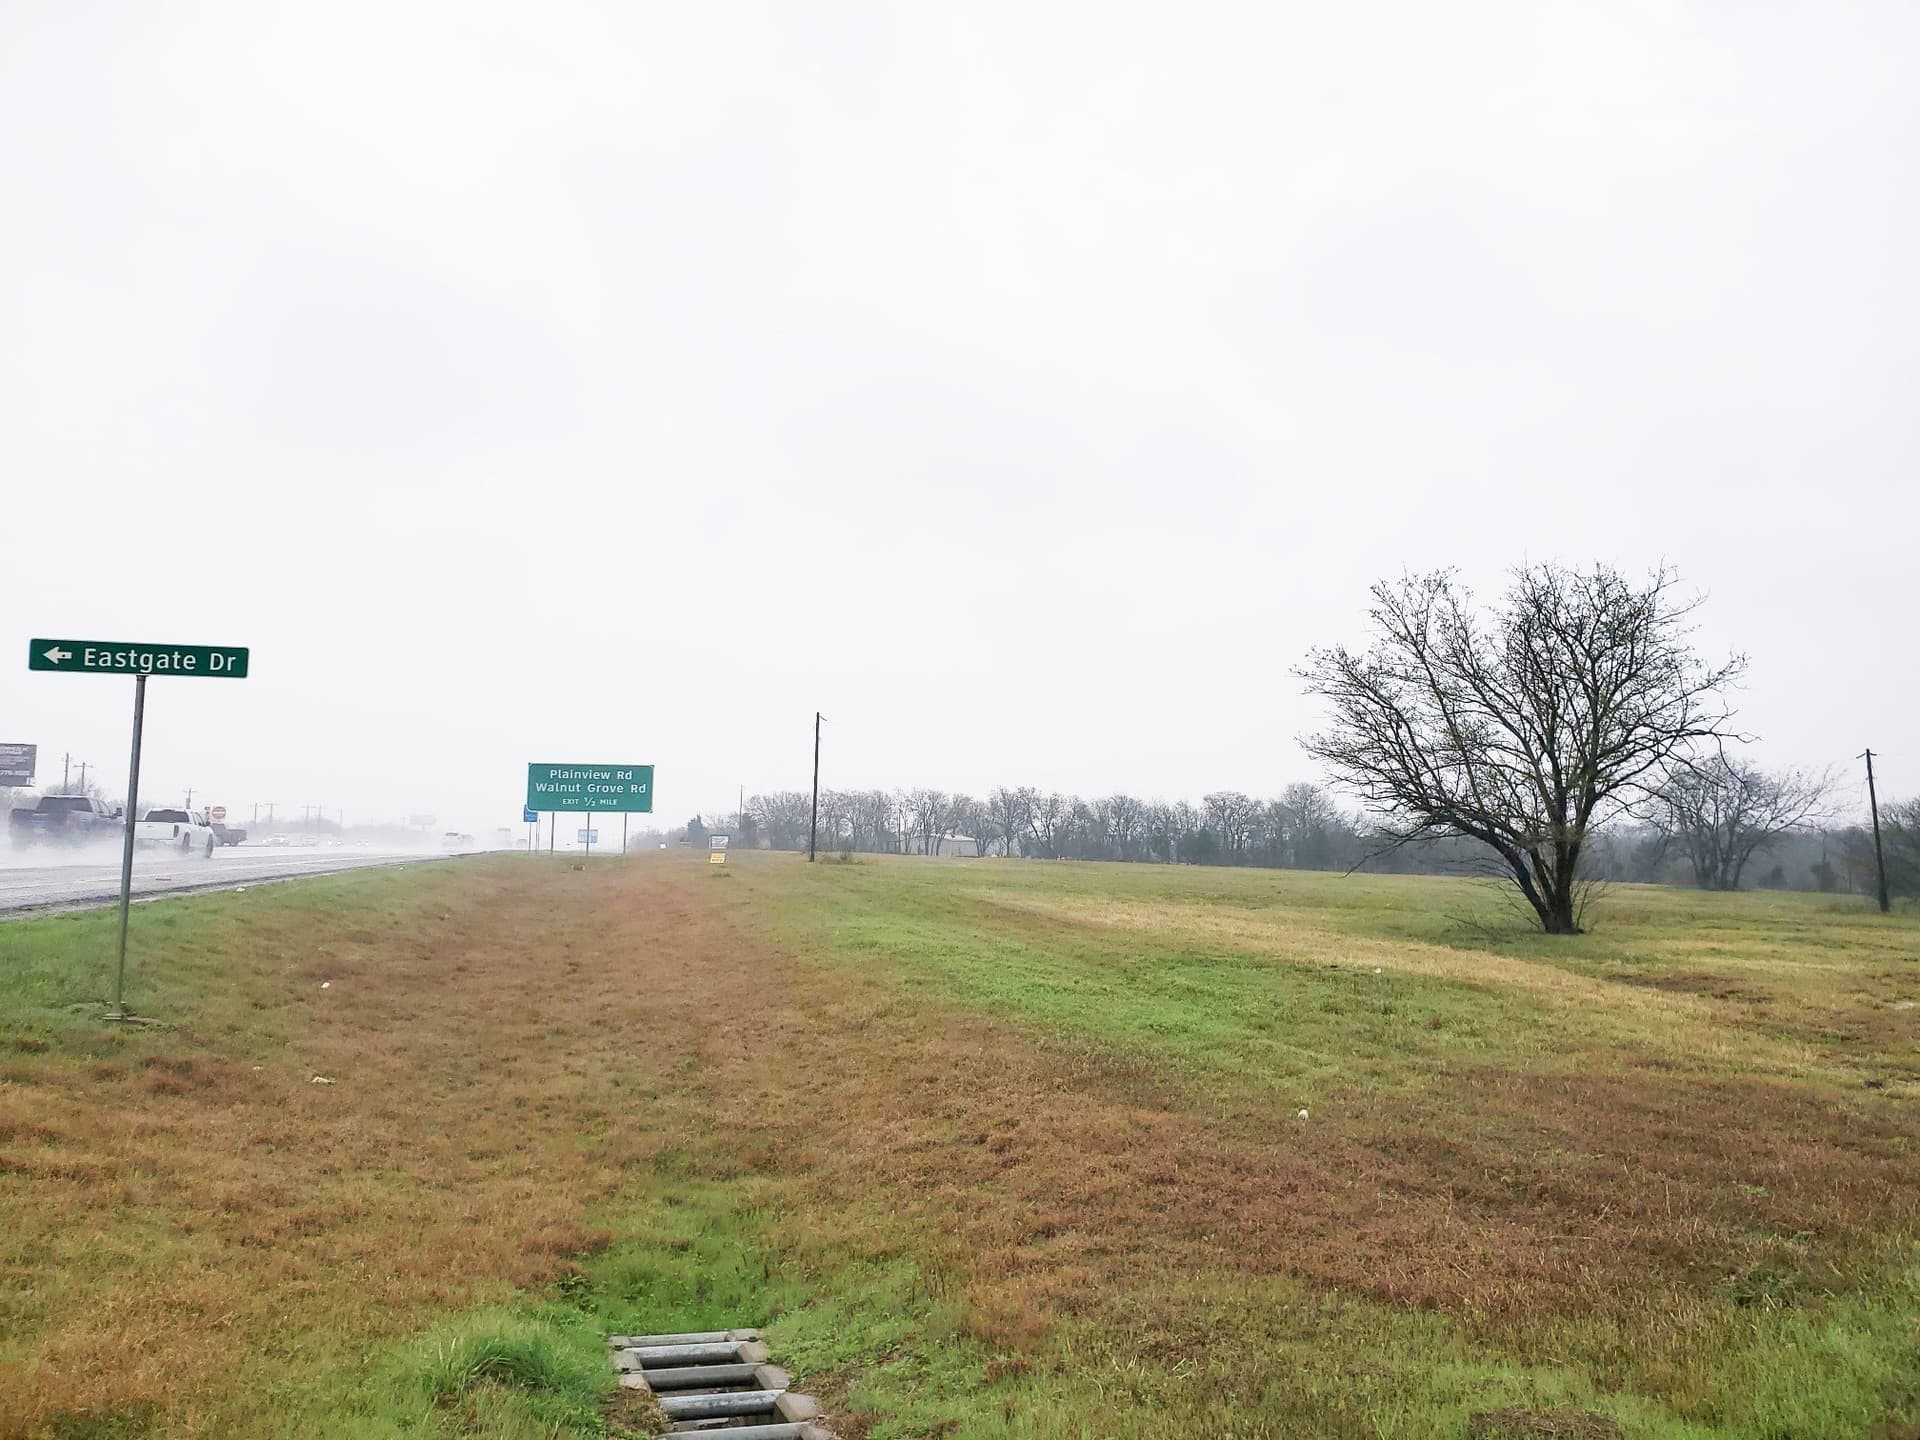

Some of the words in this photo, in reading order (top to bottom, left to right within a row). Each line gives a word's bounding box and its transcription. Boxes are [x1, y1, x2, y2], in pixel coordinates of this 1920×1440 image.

[84, 648, 196, 673] Eastgate
[209, 653, 236, 671] Dr
[550, 769, 611, 780] Plainview
[617, 770, 633, 780] Rd
[535, 782, 581, 793] Walnut
[587, 783, 624, 793] Grove
[630, 783, 646, 793] Rd
